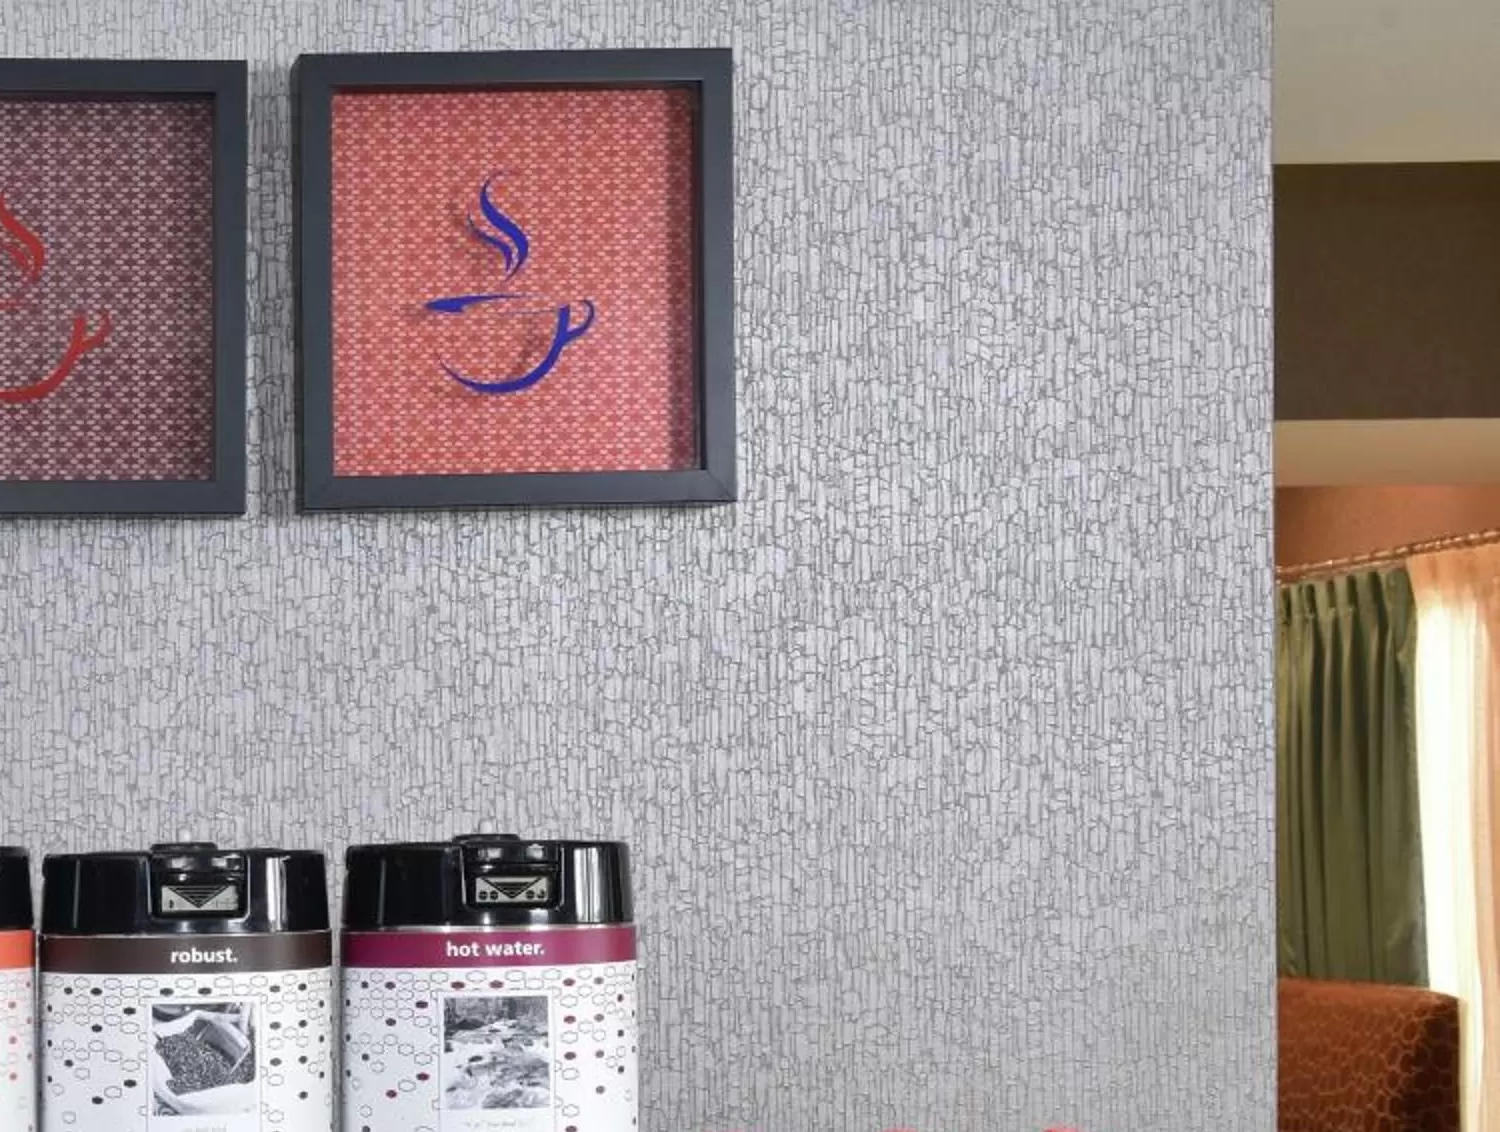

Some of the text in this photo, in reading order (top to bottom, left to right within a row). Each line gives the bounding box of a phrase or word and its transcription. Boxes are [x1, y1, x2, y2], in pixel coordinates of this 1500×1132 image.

[171, 948, 238, 963] robust.
[446, 940, 545, 957] hot water.
